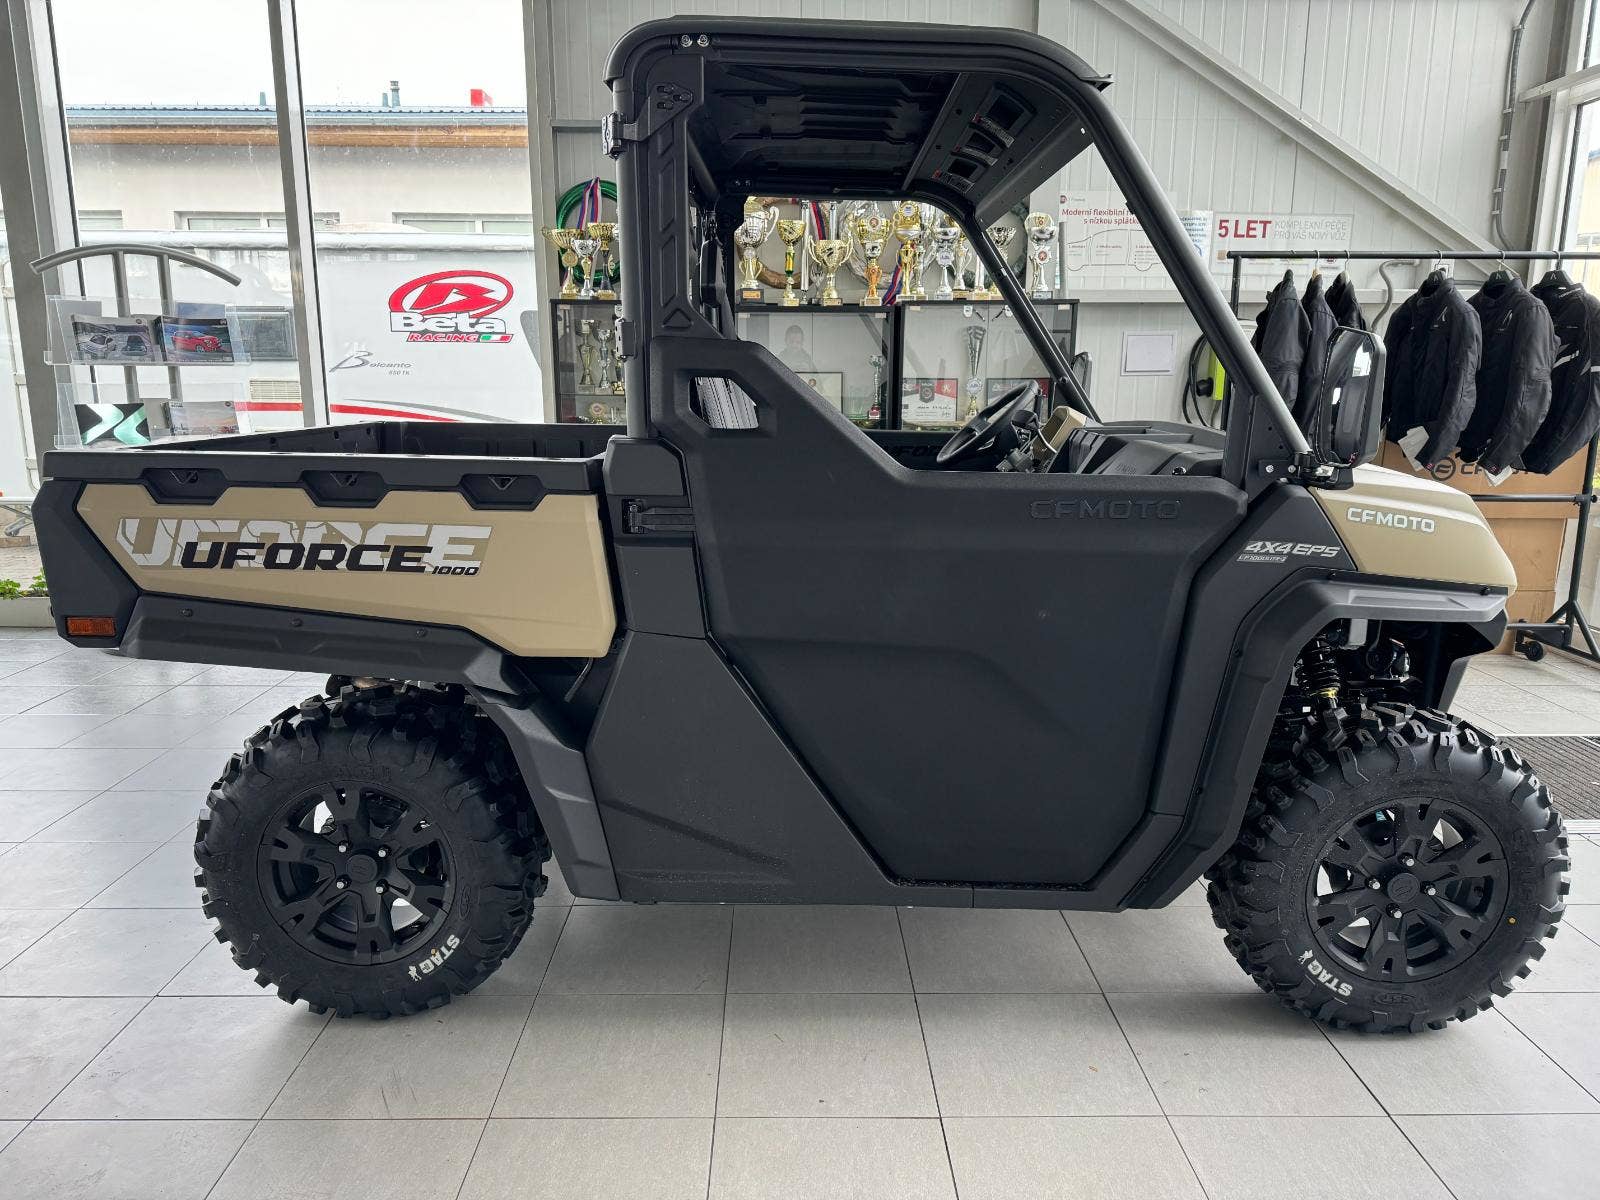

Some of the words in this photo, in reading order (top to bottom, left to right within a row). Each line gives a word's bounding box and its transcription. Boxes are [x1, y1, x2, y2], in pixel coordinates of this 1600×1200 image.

[1061, 208, 1091, 216] Moderní
[1093, 208, 1125, 216] flexibilní
[1089, 217, 1112, 225] nízkou
[1218, 219, 1229, 238] 5
[1233, 219, 1272, 238] LET
[1273, 230, 1291, 240] PRO
[390, 311, 506, 334] Beta
[408, 333, 478, 342] RACING
[1029, 499, 1183, 520] CFMOTO
[1347, 507, 1436, 534] CFMOTO
[180, 541, 433, 573] UFORCE
[431, 565, 480, 576] 1000
[418, 934, 460, 974] STAG
[1307, 959, 1353, 996] STAG
